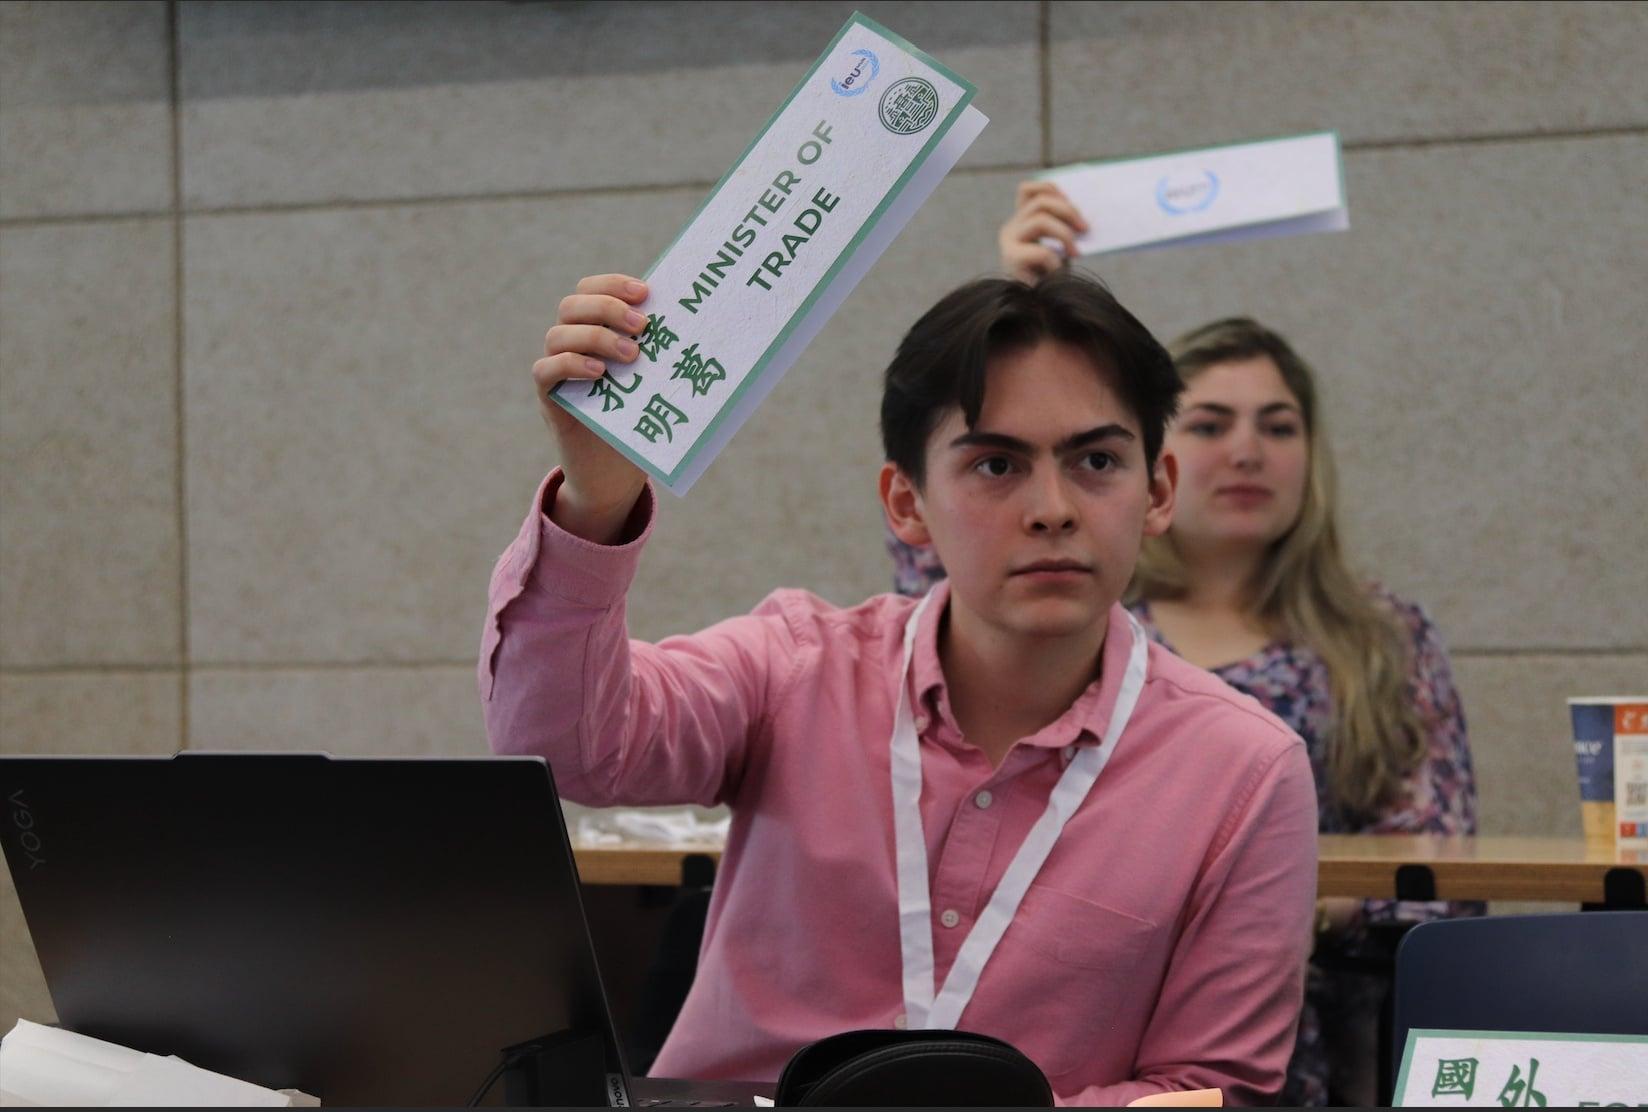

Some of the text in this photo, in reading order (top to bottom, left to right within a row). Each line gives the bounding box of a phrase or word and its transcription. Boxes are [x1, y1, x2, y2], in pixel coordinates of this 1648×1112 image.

[678, 119, 834, 315] MINISTER OF
[746, 187, 841, 291] TRADE
[9, 788, 47, 870] YOGA
[611, 1076, 625, 1107] novo
